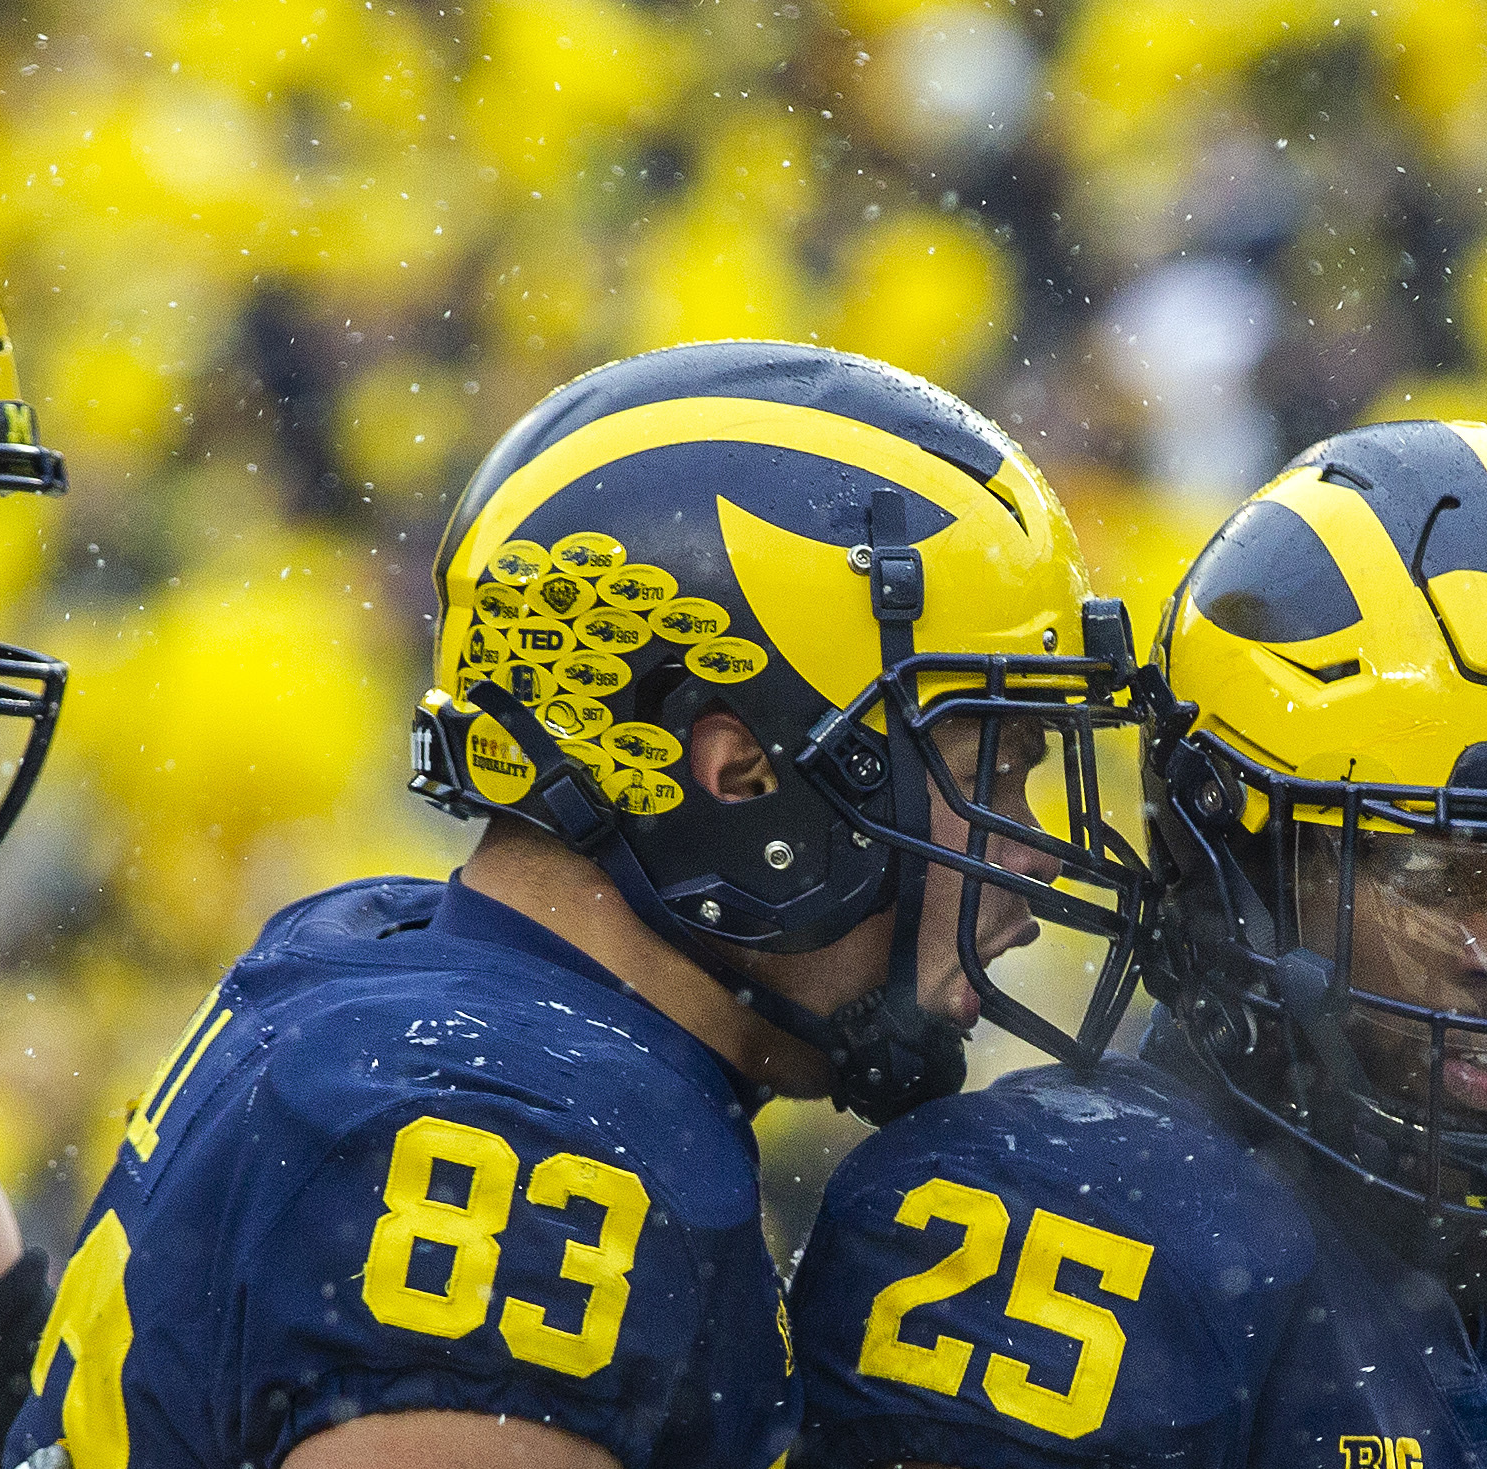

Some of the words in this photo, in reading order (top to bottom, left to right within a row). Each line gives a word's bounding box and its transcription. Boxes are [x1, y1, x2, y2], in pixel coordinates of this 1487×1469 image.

[641, 586, 664, 600] 970
[693, 619, 718, 634] 973
[518, 628, 564, 650] TED
[616, 630, 639, 644] 969
[731, 658, 754, 673] 974
[582, 707, 604, 721] 967
[645, 746, 669, 762] 972
[472, 752, 530, 778] EQUALITY
[655, 784, 675, 799] 971
[361, 1114, 652, 1380] 83
[857, 1176, 1155, 1441] 25
